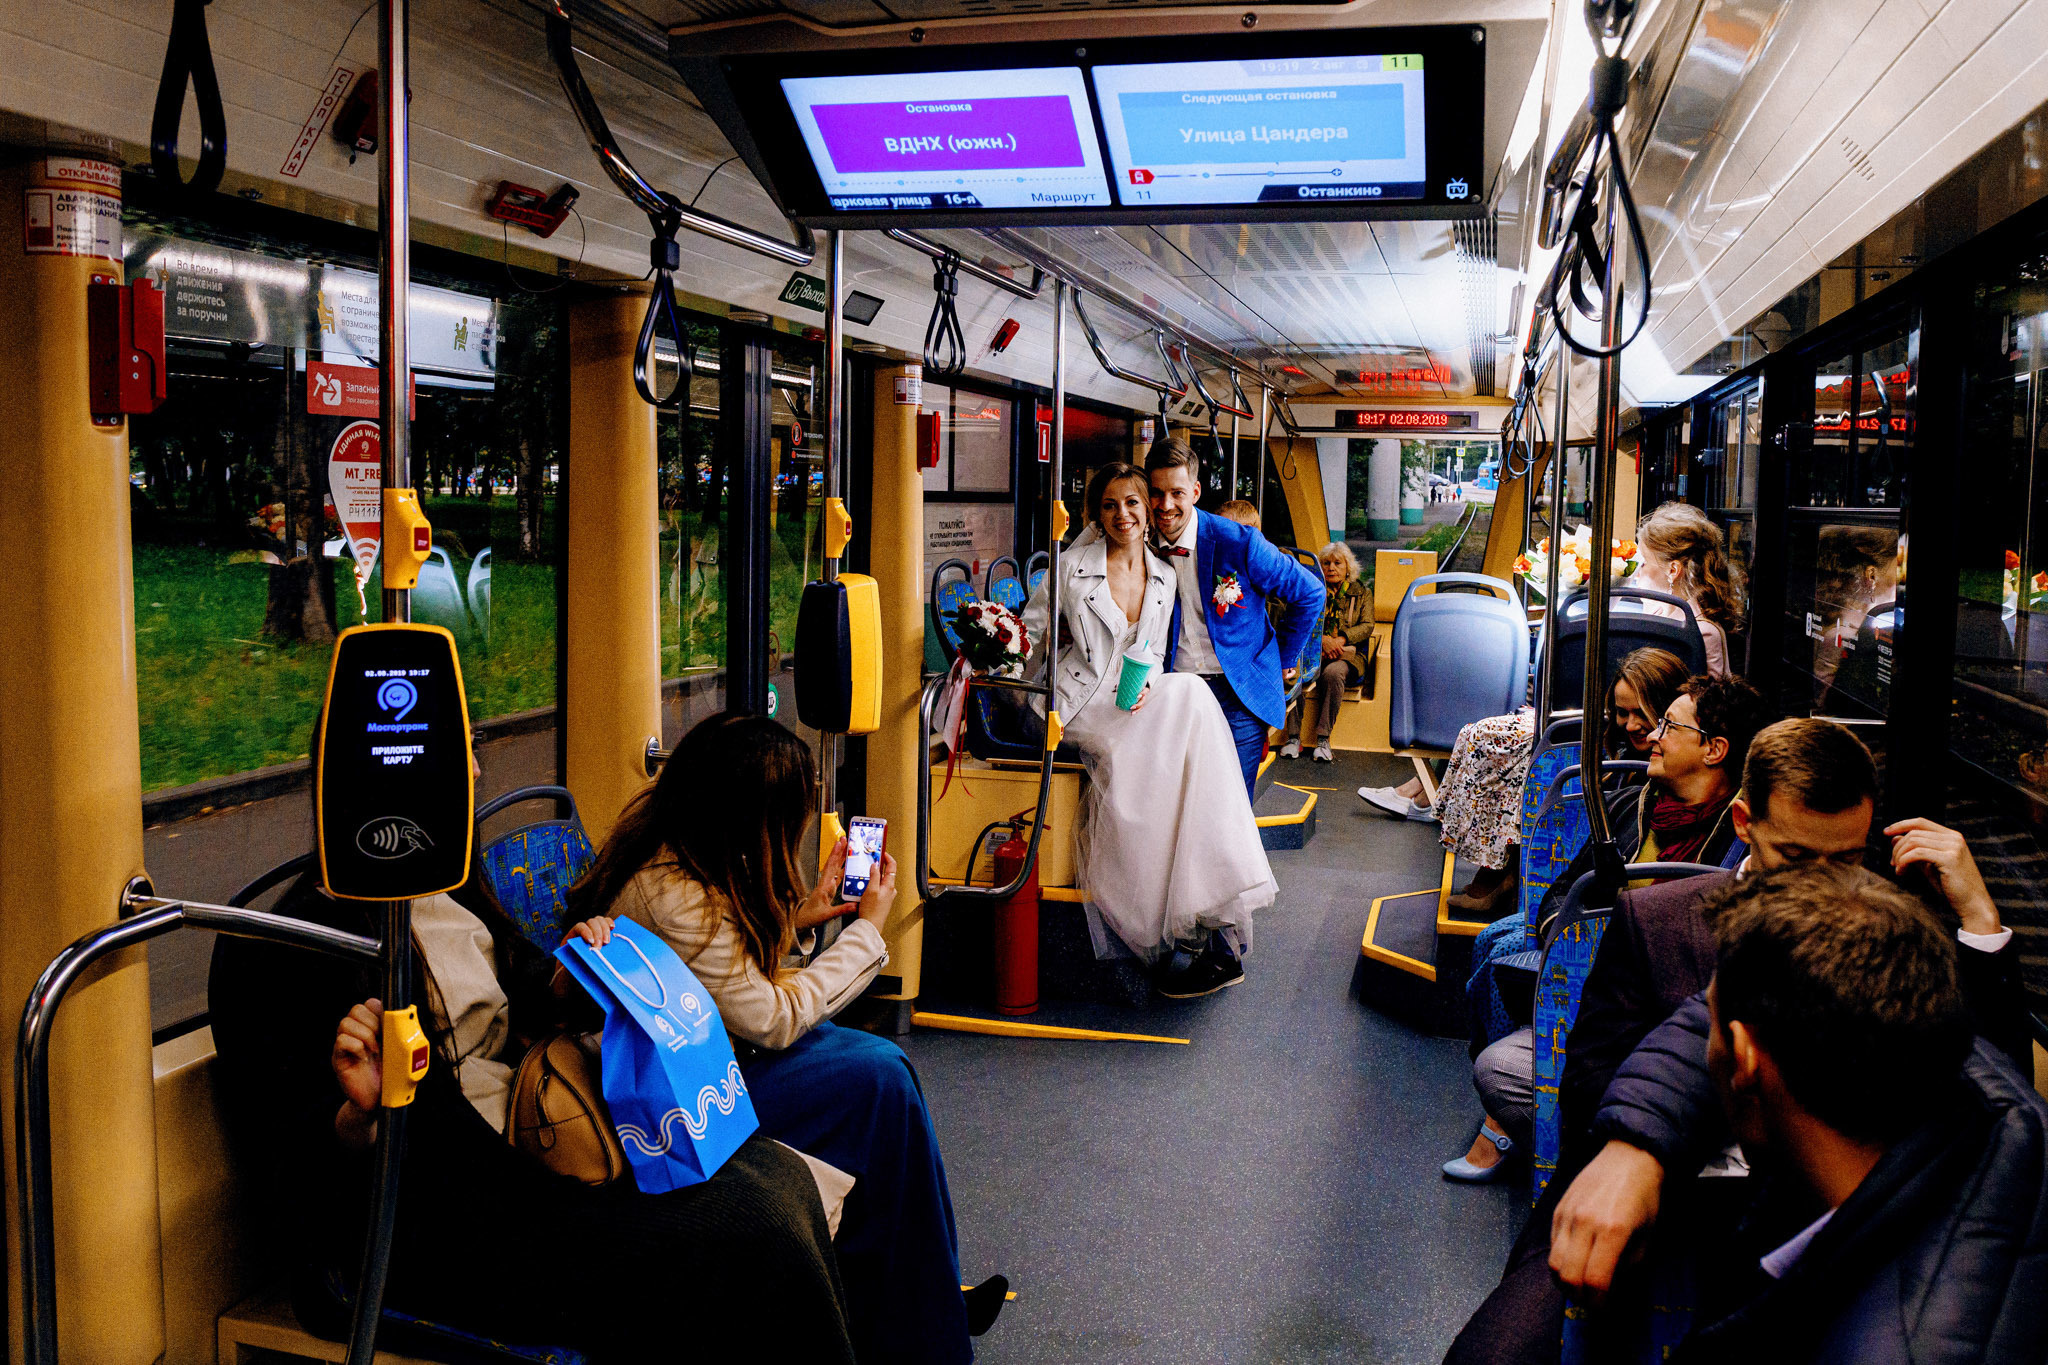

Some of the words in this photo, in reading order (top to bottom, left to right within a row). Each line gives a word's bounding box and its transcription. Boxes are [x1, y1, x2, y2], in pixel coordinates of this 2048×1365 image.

[1391, 56, 1409, 68] 11
[316, 73, 347, 118] СТОП
[1181, 92, 1263, 104] Следующая
[1265, 90, 1337, 101] остановка
[905, 102, 973, 113] Остановка
[1179, 127, 1247, 144] Улица
[1252, 125, 1349, 143] Цандера
[287, 126, 316, 172] КРАН
[883, 136, 945, 155] ВДНХ
[948, 132, 1017, 153] (южн.)
[1136, 190, 1152, 200] 11
[1298, 185, 1382, 197] Останкино
[1449, 186, 1464, 194] TV
[831, 196, 889, 208] арковая
[890, 196, 932, 208] улица
[943, 193, 976, 205] 16-я
[1031, 192, 1096, 204] Маршрут
[177, 260, 188, 271] Во
[190, 264, 219, 275] время
[176, 276, 223, 292] движения
[176, 291, 226, 307] держитесь
[341, 291, 363, 303] Места
[364, 295, 377, 305] для
[177, 306, 187, 316] за
[189, 308, 228, 322] поручни
[346, 307, 379, 319] ограниче
[347, 333, 379, 345] престаре
[1358, 413, 1386, 425] 19:17
[1390, 413, 1448, 426] 02.08.2019
[338, 429, 364, 456] ЕДИНАЯ
[345, 467, 380, 482] MT_FRE
[367, 722, 429, 733] Мосгортранс
[371, 745, 425, 755] ПРИЛОЖИТЕ
[383, 755, 414, 765] КАРТУ
